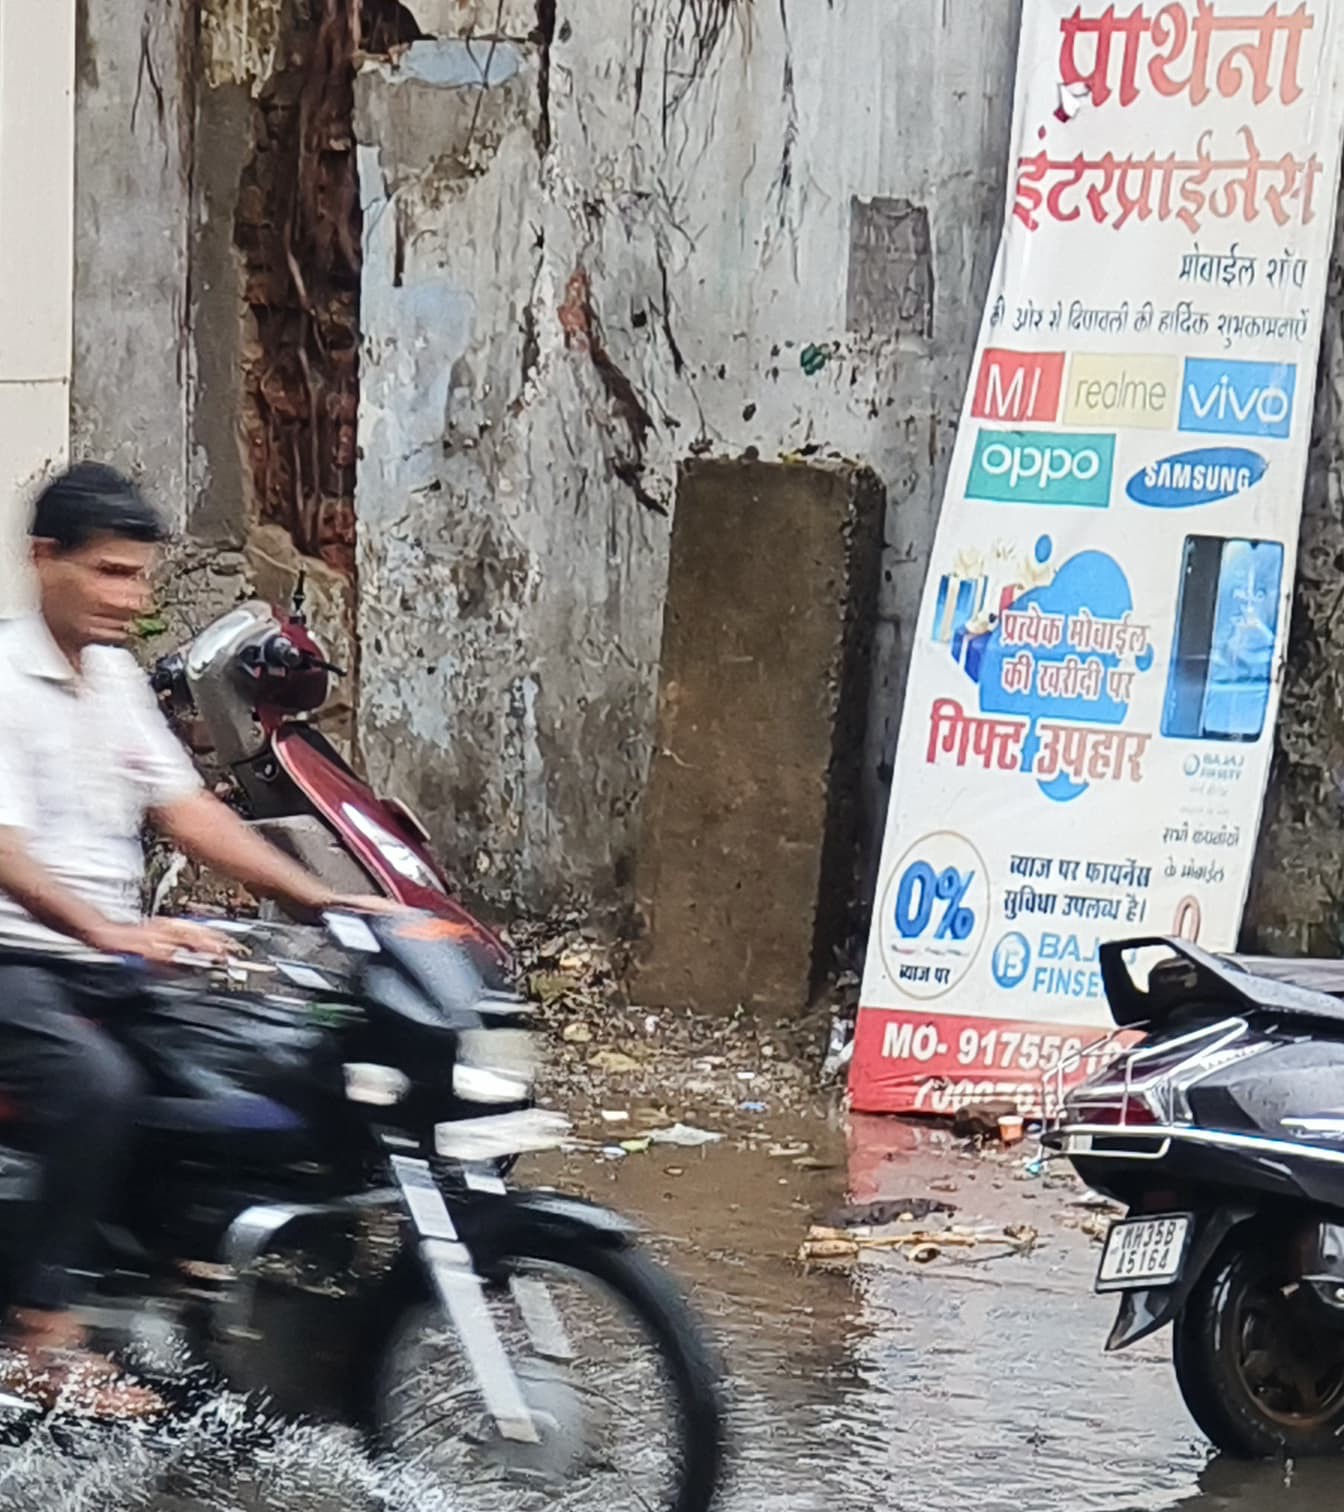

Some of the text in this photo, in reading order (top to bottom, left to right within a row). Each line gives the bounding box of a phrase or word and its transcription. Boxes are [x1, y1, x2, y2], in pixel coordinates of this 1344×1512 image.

[1074, 369, 1169, 412] realme
[1186, 372, 1289, 425] vivo
[980, 442, 1252, 494] oppo SAMSUNG
[1002, 653, 1033, 697] की
[1109, 670, 1135, 705] पर
[925, 697, 1153, 783] गिफ्ट उपहार
[1057, 858, 1081, 882] पर
[893, 858, 977, 942] 0%
[1003, 884, 1058, 921] सुविधा
[934, 966, 951, 986] पर
